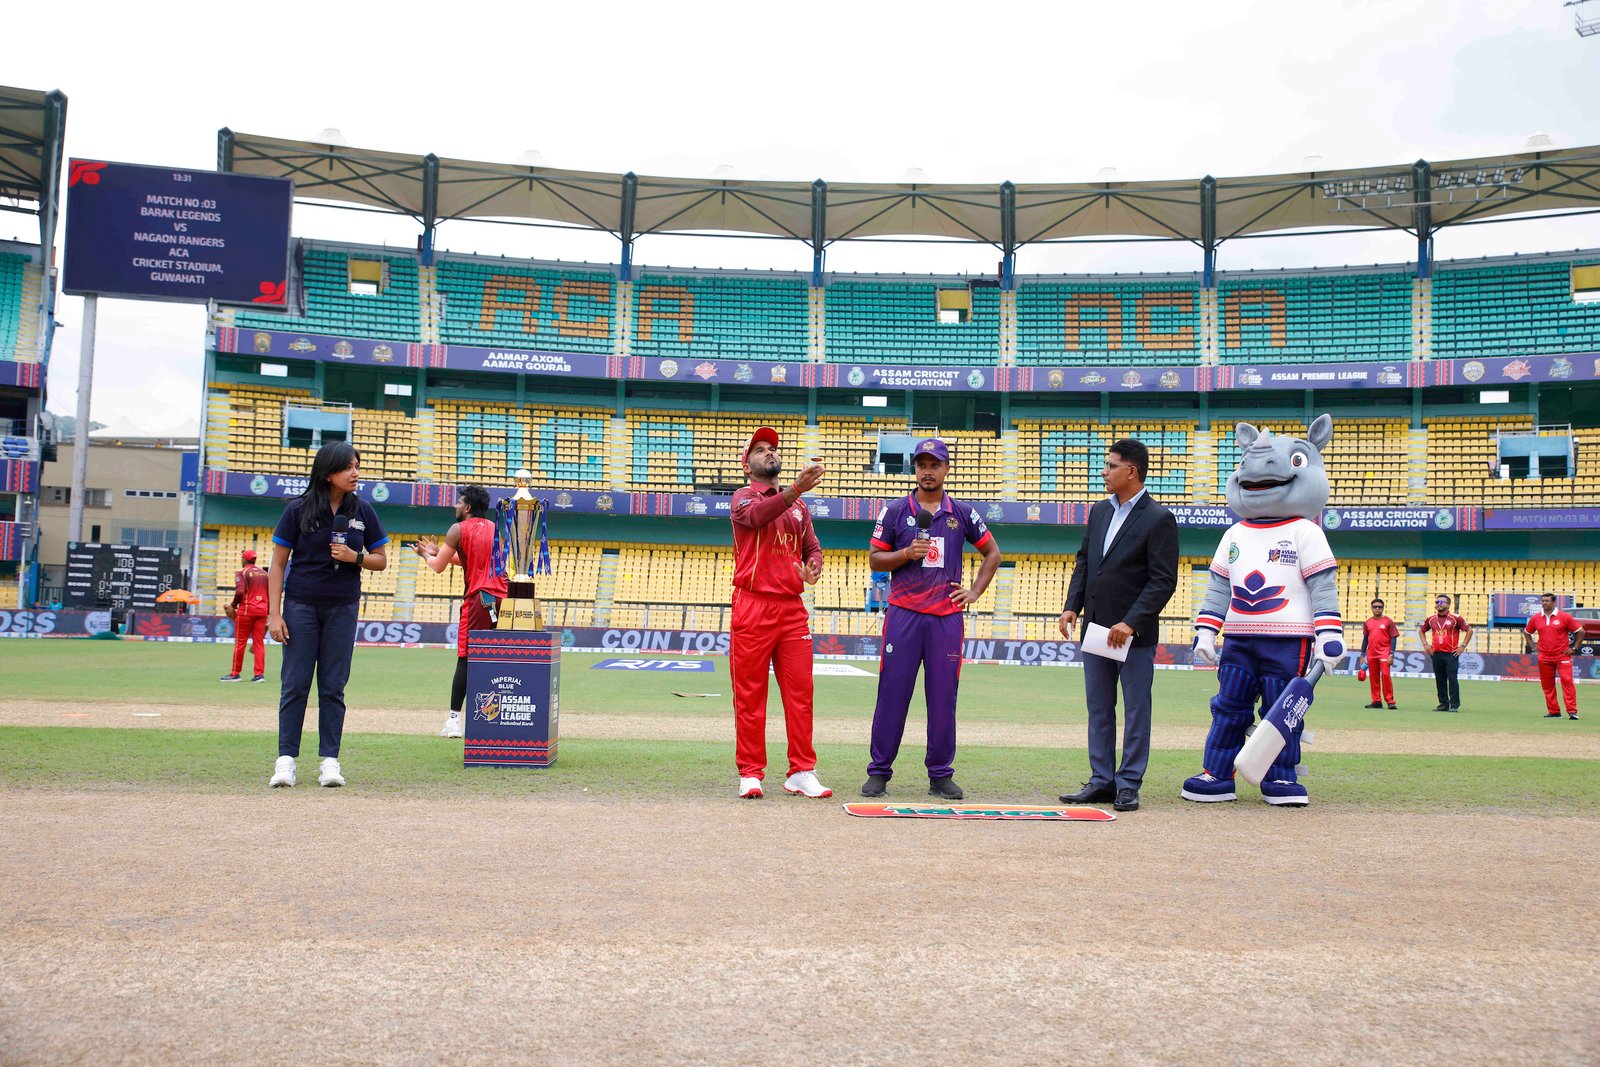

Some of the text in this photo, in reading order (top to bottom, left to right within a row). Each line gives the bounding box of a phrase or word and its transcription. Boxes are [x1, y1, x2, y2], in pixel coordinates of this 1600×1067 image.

[173, 173, 192, 182] 13:31
[146, 195, 217, 210] MATCH NO :03
[140, 207, 221, 222] BARAK LEGENDS
[174, 223, 187, 232] VS
[134, 232, 225, 248] NAGAON RANGERS
[169, 248, 190, 258] ACA
[132, 257, 224, 274] CRICKET STADIUM,
[151, 272, 205, 284] GUWAHATI
[488, 352, 529, 361] AAMAR
[482, 360, 572, 372] AAMAR GOURAB
[873, 369, 911, 378] ASSAM
[880, 378, 952, 386] ASSOCIATION
[276, 478, 310, 487] ASSA
[1194, 509, 1227, 517] AXOM,
[1188, 517, 1233, 525] GOURAB
[1513, 515, 1546, 523] MATCH
[0, 610, 56, 633] OSS
[602, 629, 730, 652] COIN TOS
[962, 640, 995, 659] IN
[1004, 642, 1076, 662] TOSS
[605, 659, 702, 669] RITS
[1347, 651, 1425, 673] TSS
[491, 676, 522, 685] IMPERIAL
[502, 696, 530, 704] ASSAM
[501, 704, 536, 712] PREMIER
[500, 712, 531, 720] LEAGUE
